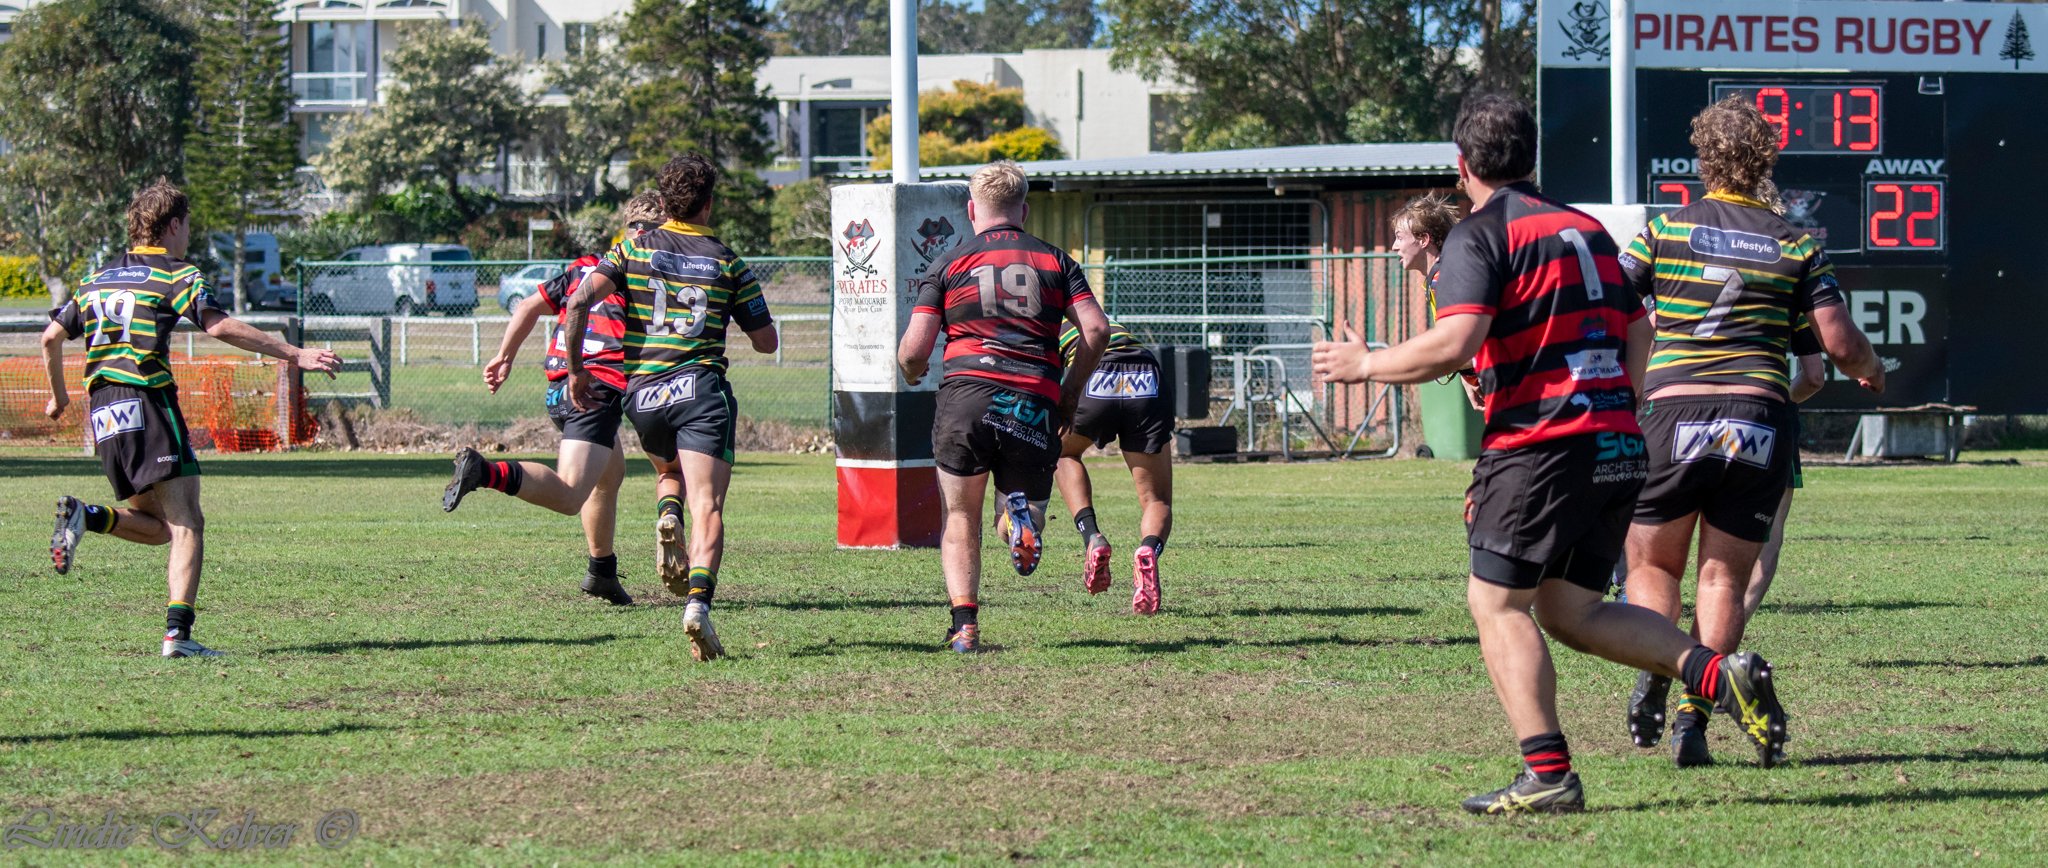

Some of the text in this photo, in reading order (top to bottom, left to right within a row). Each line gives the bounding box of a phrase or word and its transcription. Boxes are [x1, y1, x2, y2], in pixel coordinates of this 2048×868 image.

[1634, 13, 1992, 56] PIRATES RUGBY
[1651, 158, 1701, 174] HO
[1866, 159, 1945, 174] AWAY
[1870, 184, 1940, 247] 22
[985, 231, 1020, 243] 1973
[1730, 239, 1776, 254] Lifestyle.
[682, 261, 717, 272] Lifestyle.
[1558, 228, 1604, 301] 1
[837, 279, 888, 297] PIRATES
[970, 263, 1042, 318] 19
[1690, 264, 1745, 338] 7
[88, 289, 137, 346] 19
[646, 278, 708, 338] 13
[983, 412, 1049, 444] ARCHITECTURAL
[1012, 430, 1048, 450] SOLUTIONS
